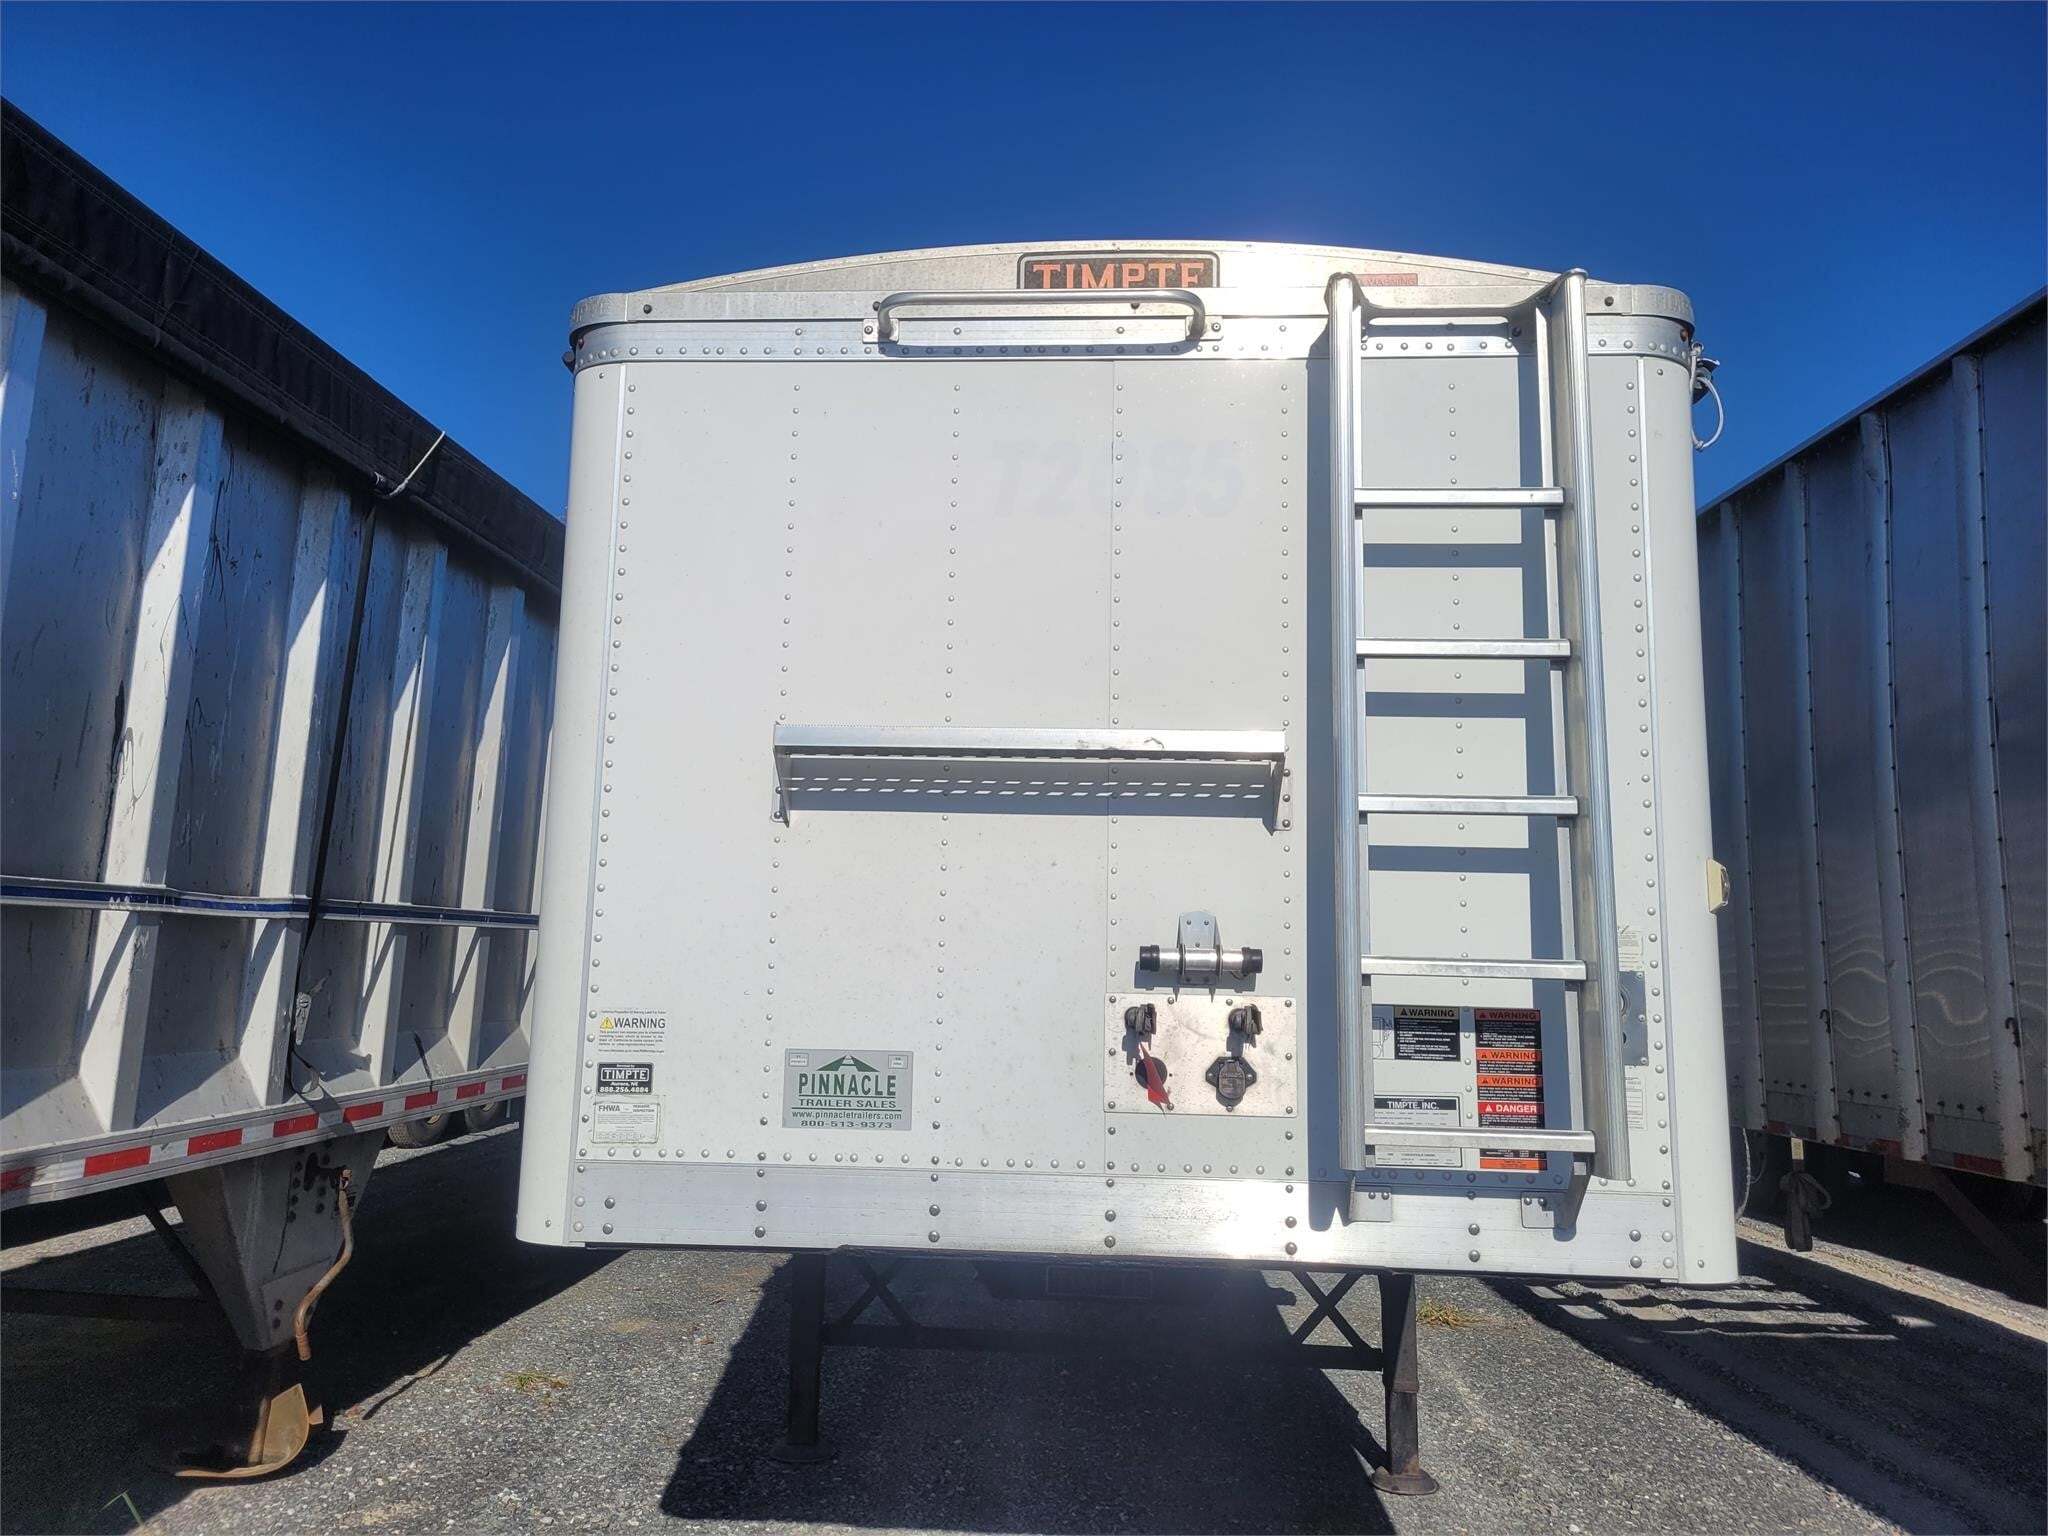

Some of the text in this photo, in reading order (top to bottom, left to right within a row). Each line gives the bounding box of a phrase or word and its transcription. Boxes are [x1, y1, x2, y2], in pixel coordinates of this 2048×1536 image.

[1409, 1007, 1455, 1018] WARNING
[1489, 1010, 1537, 1021] WARNING
[613, 1017, 666, 1029] WARNING
[1491, 1050, 1538, 1061] WARNING
[603, 1069, 647, 1080] TIMPTE
[798, 1073, 897, 1096] PINNACLE
[1492, 1077, 1538, 1087] WARNING
[799, 1098, 897, 1109] TRAILER SALES
[1495, 1104, 1538, 1114] DANGER
[792, 1110, 902, 1121] www.pinnacletrailers.com
